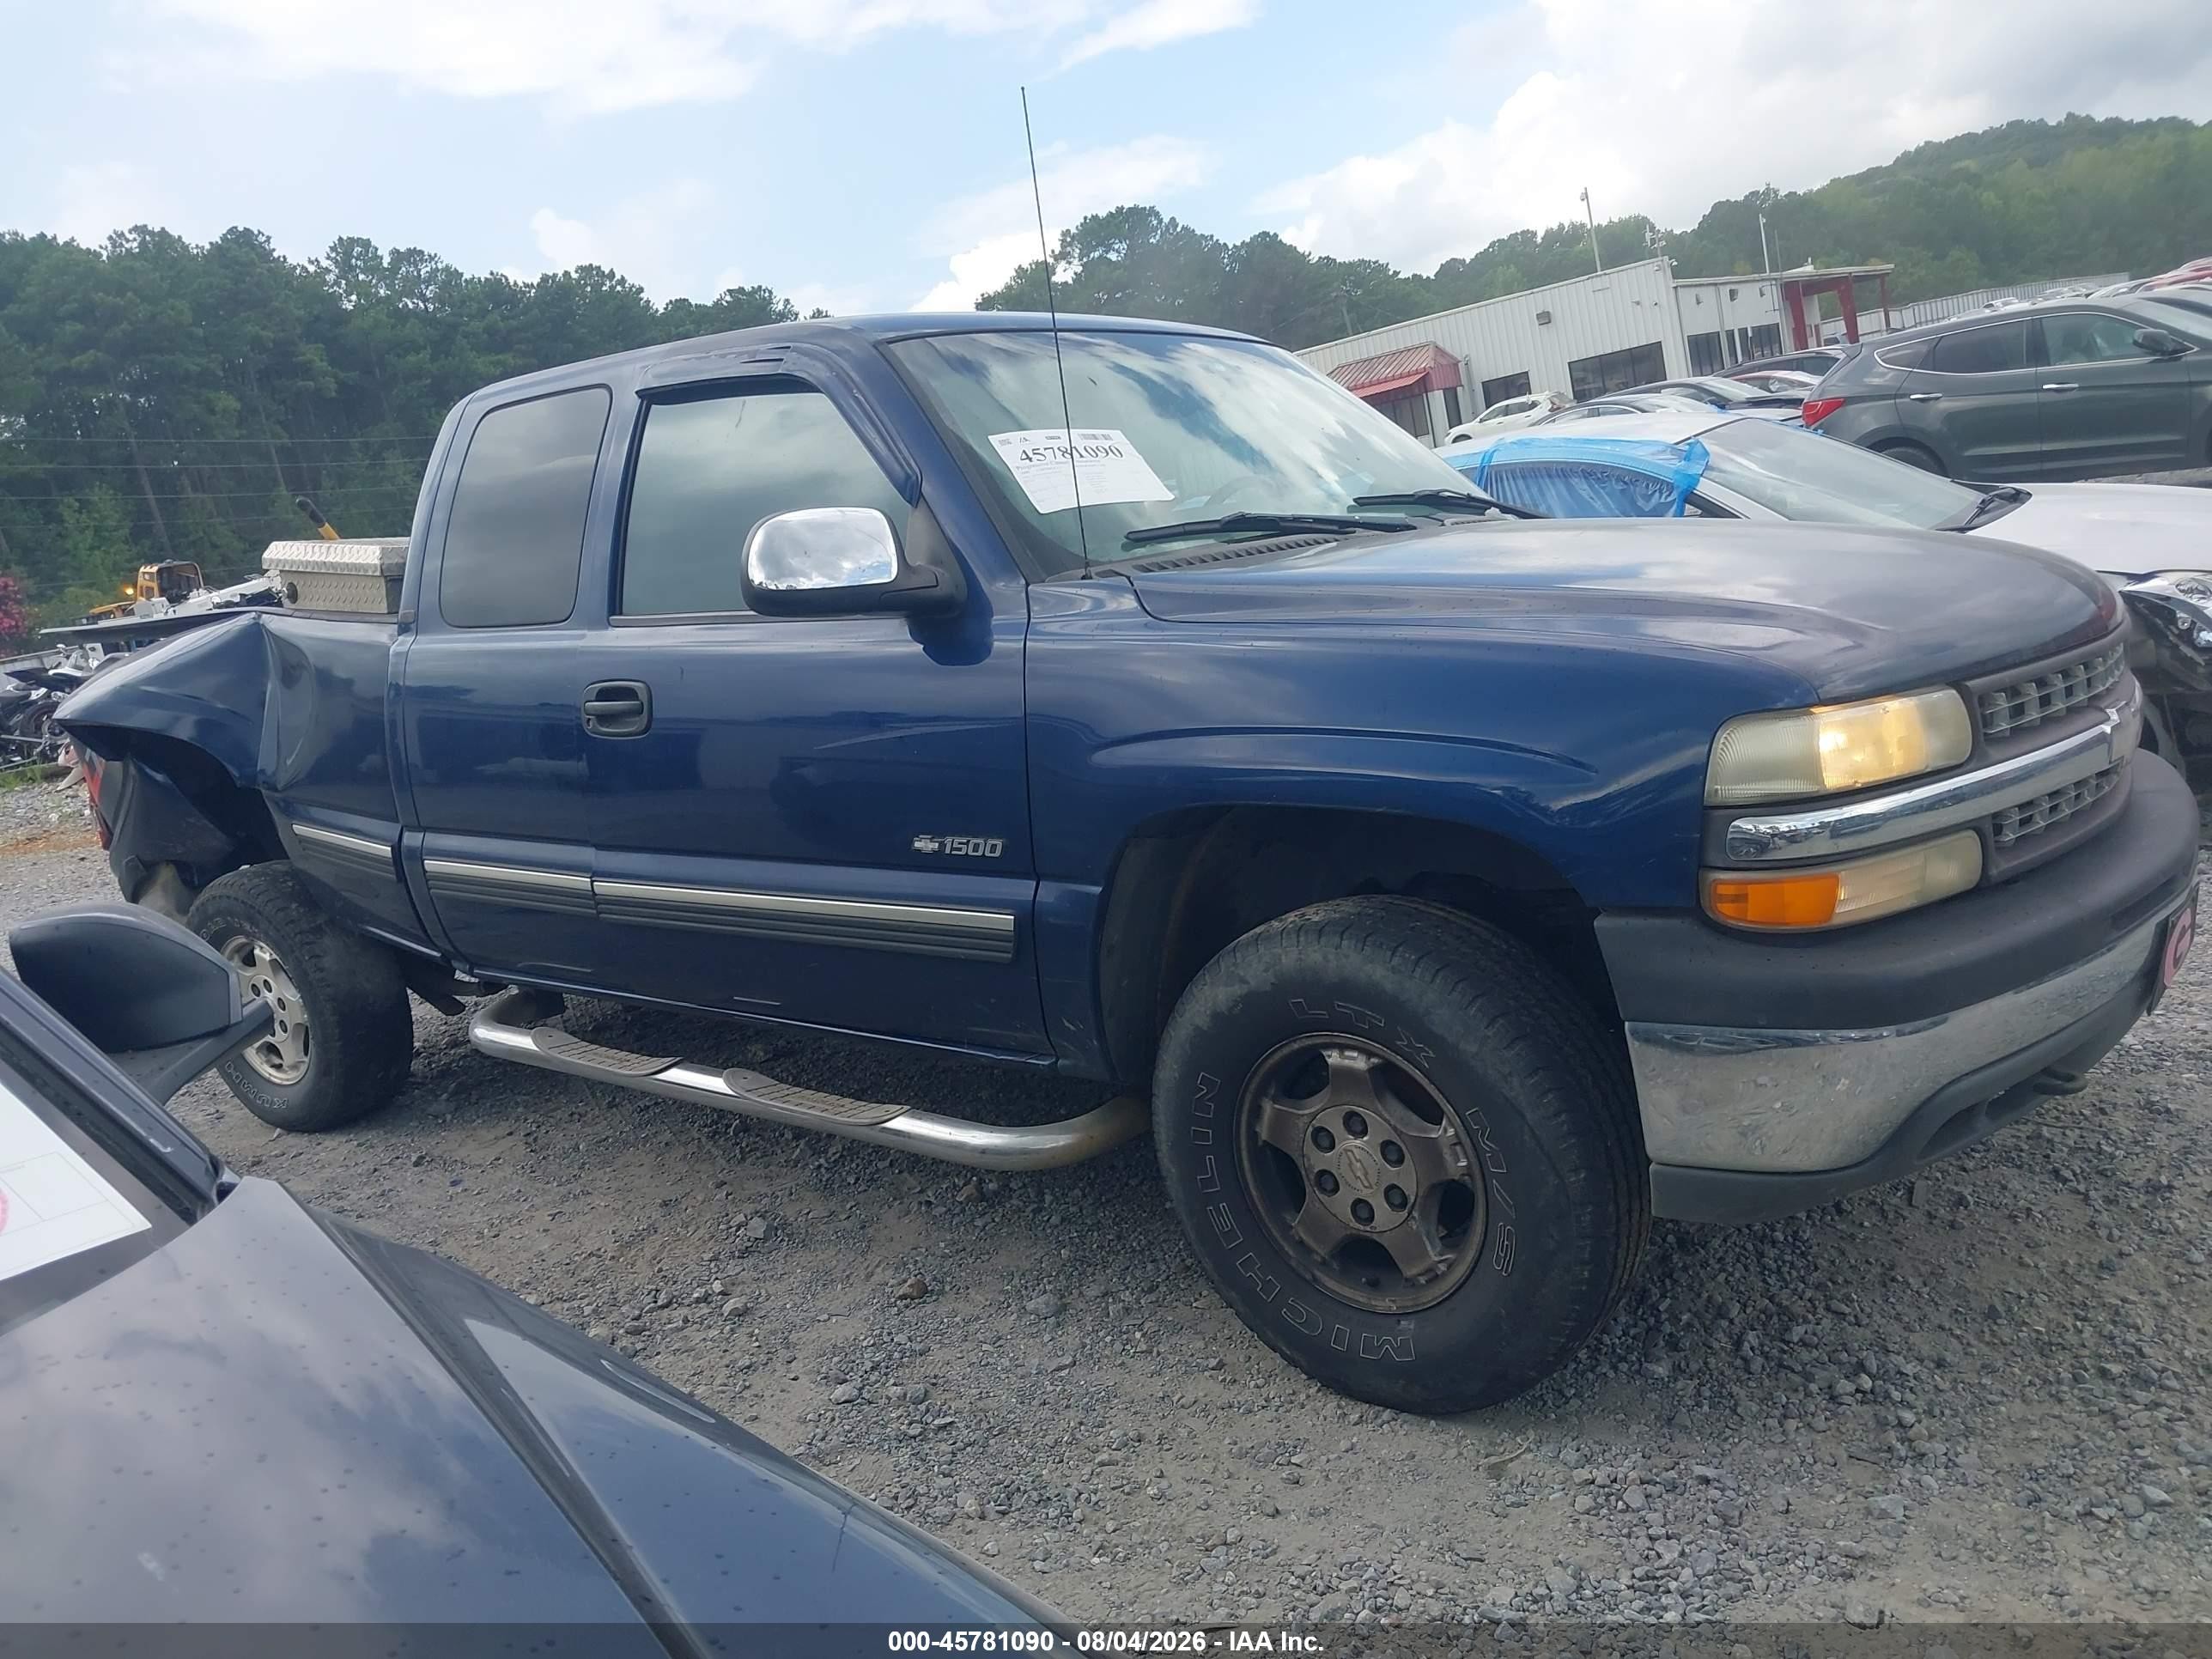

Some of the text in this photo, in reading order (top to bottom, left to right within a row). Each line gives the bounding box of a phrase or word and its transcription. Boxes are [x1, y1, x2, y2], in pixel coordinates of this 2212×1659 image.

[1020, 445, 1123, 462] 45781090
[944, 836, 1003, 858] 1500
[1288, 998, 1436, 1069] LTX
[1190, 1072, 1417, 1362] MICHELIN
